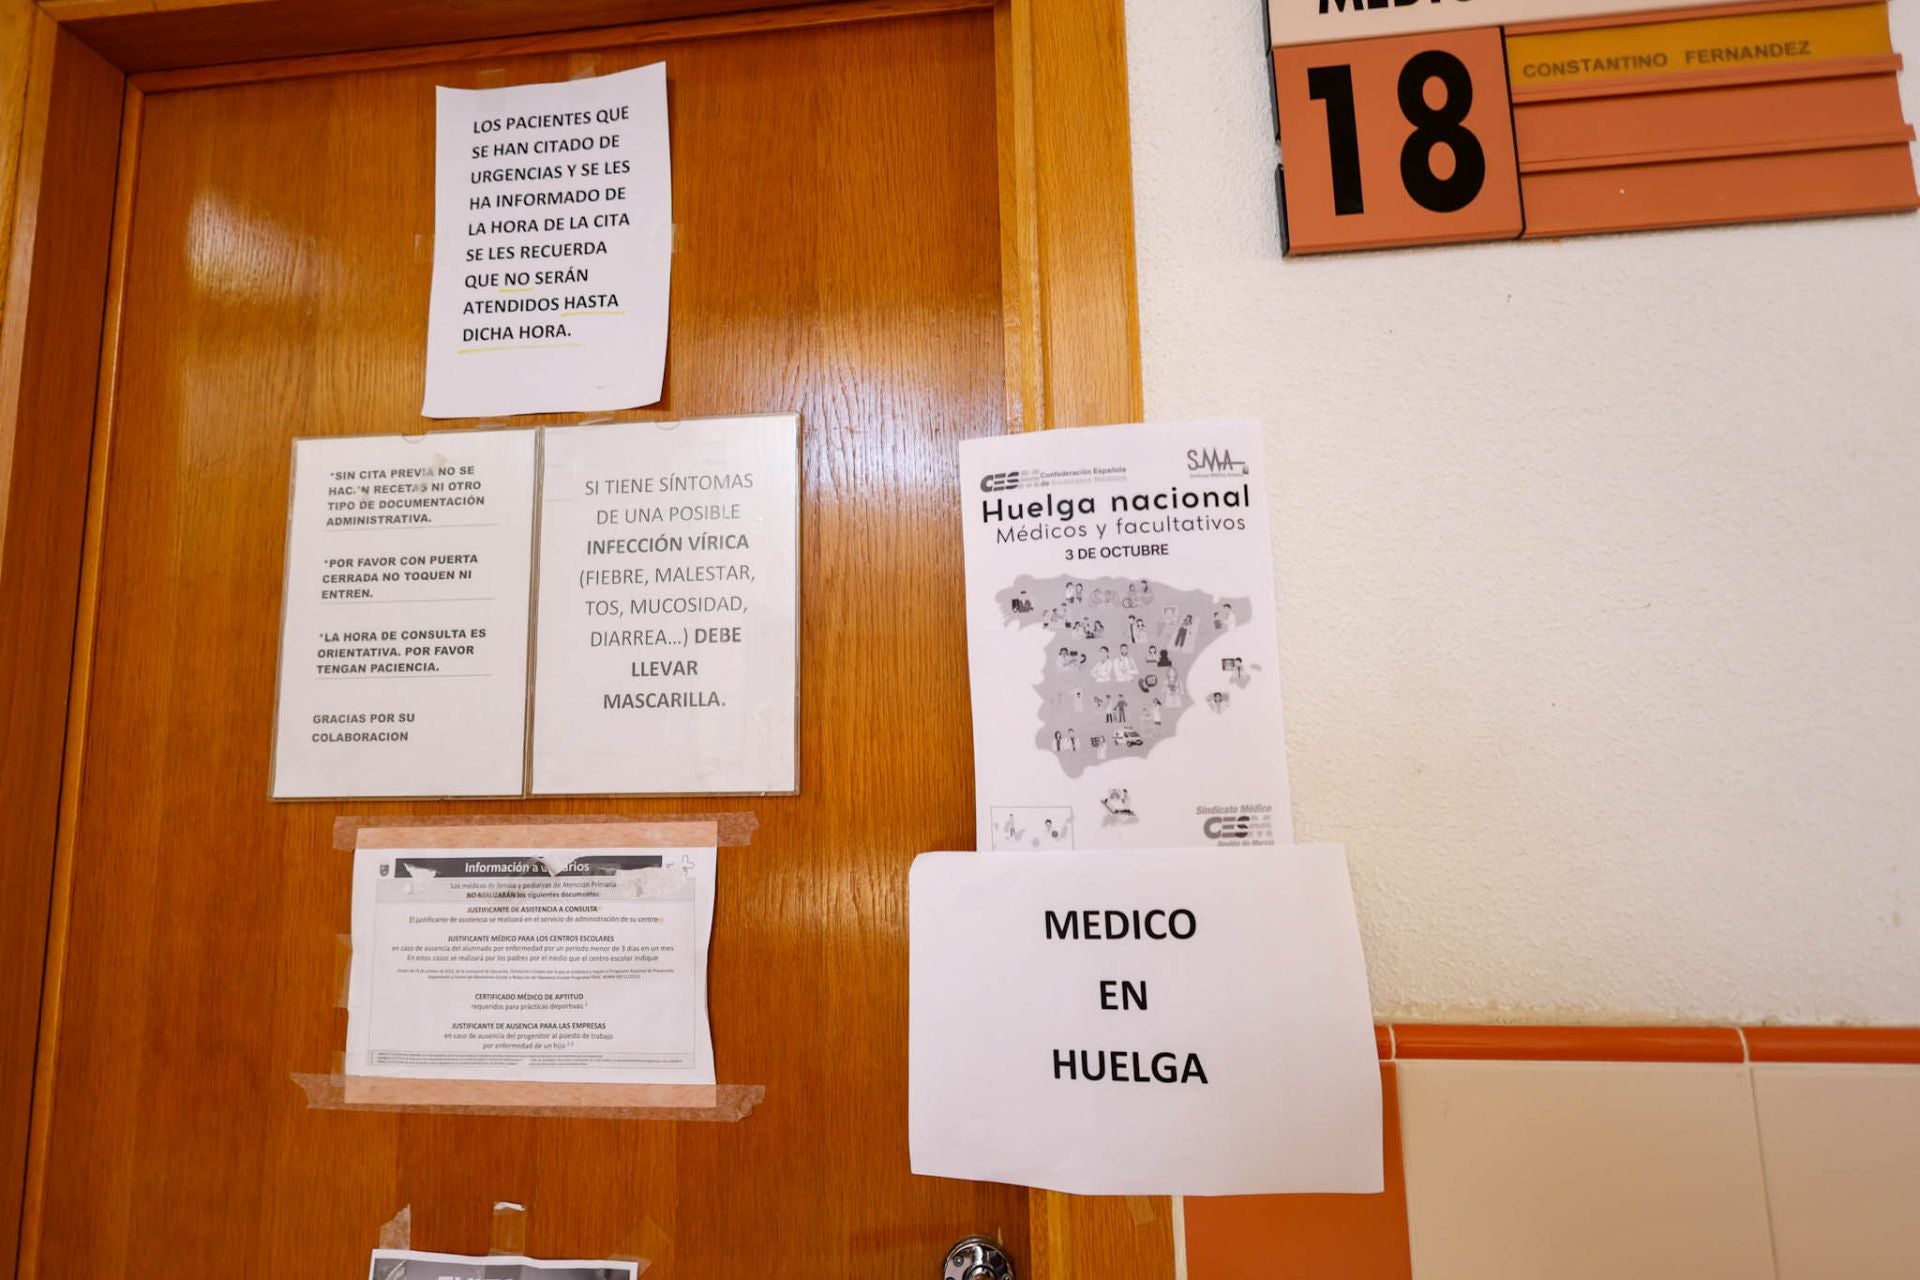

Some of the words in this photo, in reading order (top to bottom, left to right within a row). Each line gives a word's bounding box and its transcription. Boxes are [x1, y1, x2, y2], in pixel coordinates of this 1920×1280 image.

[1522, 52, 1667, 78] CONSTANTINO
[1684, 40, 1811, 64] FERNANDEZ
[473, 118, 501, 133] LOS
[506, 111, 591, 130] PACIENTES
[596, 105, 628, 123] QUE
[1307, 49, 1485, 216] 18
[471, 145, 488, 158] SE
[493, 141, 528, 156] HAN
[533, 136, 594, 153] CITADO
[599, 134, 619, 148] DE
[471, 165, 562, 184] URGENCIAS
[567, 164, 576, 177] Y
[580, 162, 598, 176] SE
[604, 160, 630, 174] LES
[469, 196, 491, 210] HA
[496, 188, 599, 207] INFORMADO
[605, 186, 625, 200] DE
[468, 222, 486, 236] LA
[491, 219, 538, 233] HORA
[544, 217, 564, 231] DE
[569, 216, 588, 229] LA
[593, 212, 629, 227] CITA
[466, 248, 483, 262] SE
[488, 246, 514, 260] LES
[520, 240, 607, 258] RECUERDA
[464, 273, 498, 289] QUE
[504, 272, 530, 285] NO
[535, 266, 588, 284] SERÁN
[463, 297, 559, 314] ATENDIDOS
[564, 294, 618, 309] HASTA
[463, 326, 513, 341] DICHA
[519, 323, 570, 339] HORA.
[358, 469, 387, 479] CITA
[437, 466, 455, 476] NO
[458, 465, 474, 475] SE
[328, 485, 370, 496] HACN
[431, 482, 444, 492] NI
[447, 480, 481, 491] OTRO
[584, 480, 598, 496] SI
[604, 477, 653, 494] TIENE
[659, 472, 752, 492] SÍNTOMAS
[327, 501, 355, 510] TIPO
[359, 498, 374, 510] DE
[378, 494, 484, 509] DOCUMENTACIÓN
[982, 493, 1094, 523] Huelga
[1111, 483, 1249, 511] nacional
[326, 513, 431, 526] ADMINISTRATIVA.
[596, 509, 618, 525] DE
[625, 507, 663, 523] UNA
[669, 504, 739, 521] POSIBLE
[996, 522, 1087, 544] Médicos
[1096, 523, 1106, 539] y
[1116, 514, 1245, 534] facultativos
[587, 533, 682, 555] INFECCIÓN
[688, 531, 749, 550] VÍRICA
[1065, 548, 1073, 560] 3
[1077, 547, 1096, 559] DE
[1099, 543, 1168, 558] OCTUBRE
[357, 556, 396, 567] FAVOR
[399, 555, 426, 566] CON
[429, 554, 478, 564] PUERTA
[322, 572, 378, 583] CERRADA
[382, 572, 400, 581] NO
[403, 570, 454, 581] TOQUEN
[458, 569, 471, 579] NI
[579, 568, 648, 589] (FIEBRE,
[655, 564, 754, 583] MALESTAR,
[321, 588, 373, 599] ENTREN.
[584, 599, 623, 617] TOS,
[630, 595, 747, 614] MUCOSIDAD,
[343, 631, 377, 642] HORA
[380, 630, 397, 641] DE
[400, 629, 466, 640] CONSULTA
[470, 628, 486, 638] ES
[590, 627, 688, 647] DIARREA...)
[694, 626, 741, 644] DEBE
[317, 647, 400, 658] ORIENTATIVA.
[404, 646, 430, 656] POR
[434, 645, 474, 655] FAVOR
[316, 663, 366, 674] TENGAN
[370, 662, 439, 672] PACIENCIA.
[631, 660, 698, 677] LLEVAR
[603, 691, 725, 709] MASCARILLA.
[312, 713, 366, 724] GRACIAS
[369, 713, 394, 723] POR
[398, 712, 415, 723] SU
[311, 731, 408, 742] COLABORACION
[1195, 805, 1238, 815] Sindicato
[1239, 803, 1272, 813] Médico
[465, 861, 529, 872] Información
[532, 863, 539, 873] a
[1044, 908, 1196, 940] MEDICO
[490, 934, 516, 942] MÉDICO
[549, 934, 578, 942] CENTROS
[516, 992, 543, 1000] MÉDICO
[1099, 980, 1147, 1010] EN
[505, 1022, 538, 1030] AUSENCIA
[1053, 1048, 1208, 1084] HUELGA
